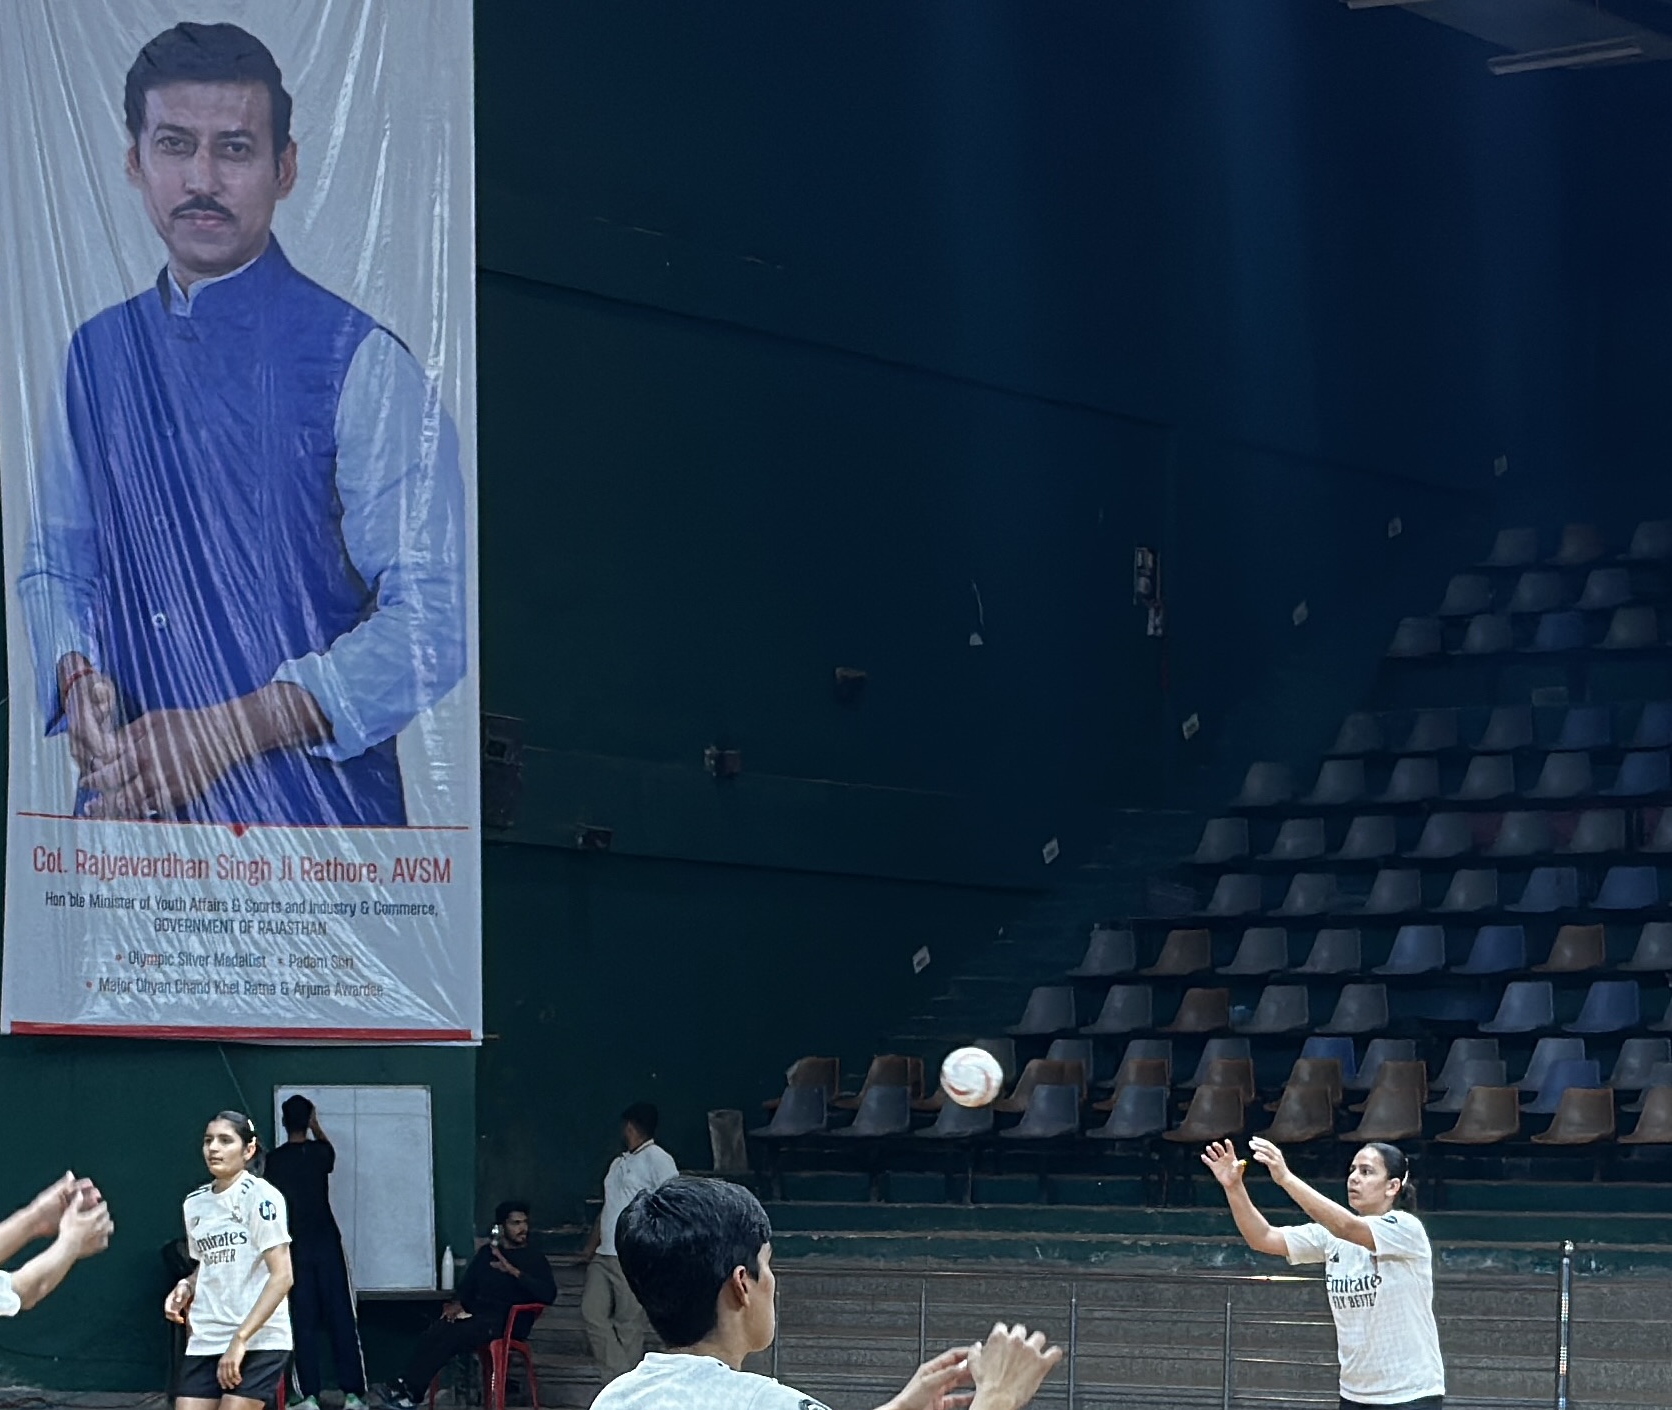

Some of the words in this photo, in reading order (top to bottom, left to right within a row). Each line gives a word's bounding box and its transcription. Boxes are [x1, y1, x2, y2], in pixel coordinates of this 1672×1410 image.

[33, 846, 68, 874] Col.
[75, 848, 209, 881] Rajyavardhan
[217, 854, 272, 887] Singh
[280, 856, 293, 882] Ji
[300, 857, 384, 885] Rathore,
[391, 857, 451, 884] AVSM
[90, 893, 134, 909] Minister
[140, 895, 151, 910] of
[155, 896, 186, 911] Youth
[190, 897, 228, 912] Affairs
[244, 899, 281, 916] Sports
[285, 900, 306, 914] and
[310, 901, 357, 917] Industry
[360, 901, 370, 914] &
[374, 902, 438, 917] Commerce,
[154, 918, 236, 934] GOVERNMENT
[239, 920, 254, 934] OF
[258, 920, 327, 935] RAJASTHAN
[128, 950, 175, 968] Olympic
[178, 952, 210, 967] Silver
[99, 977, 132, 994] Major
[136, 978, 171, 995] Dhyan
[175, 979, 210, 994] Chand
[280, 982, 290, 995] &
[294, 982, 330, 998] Arjuna
[197, 1231, 247, 1253] mirates
